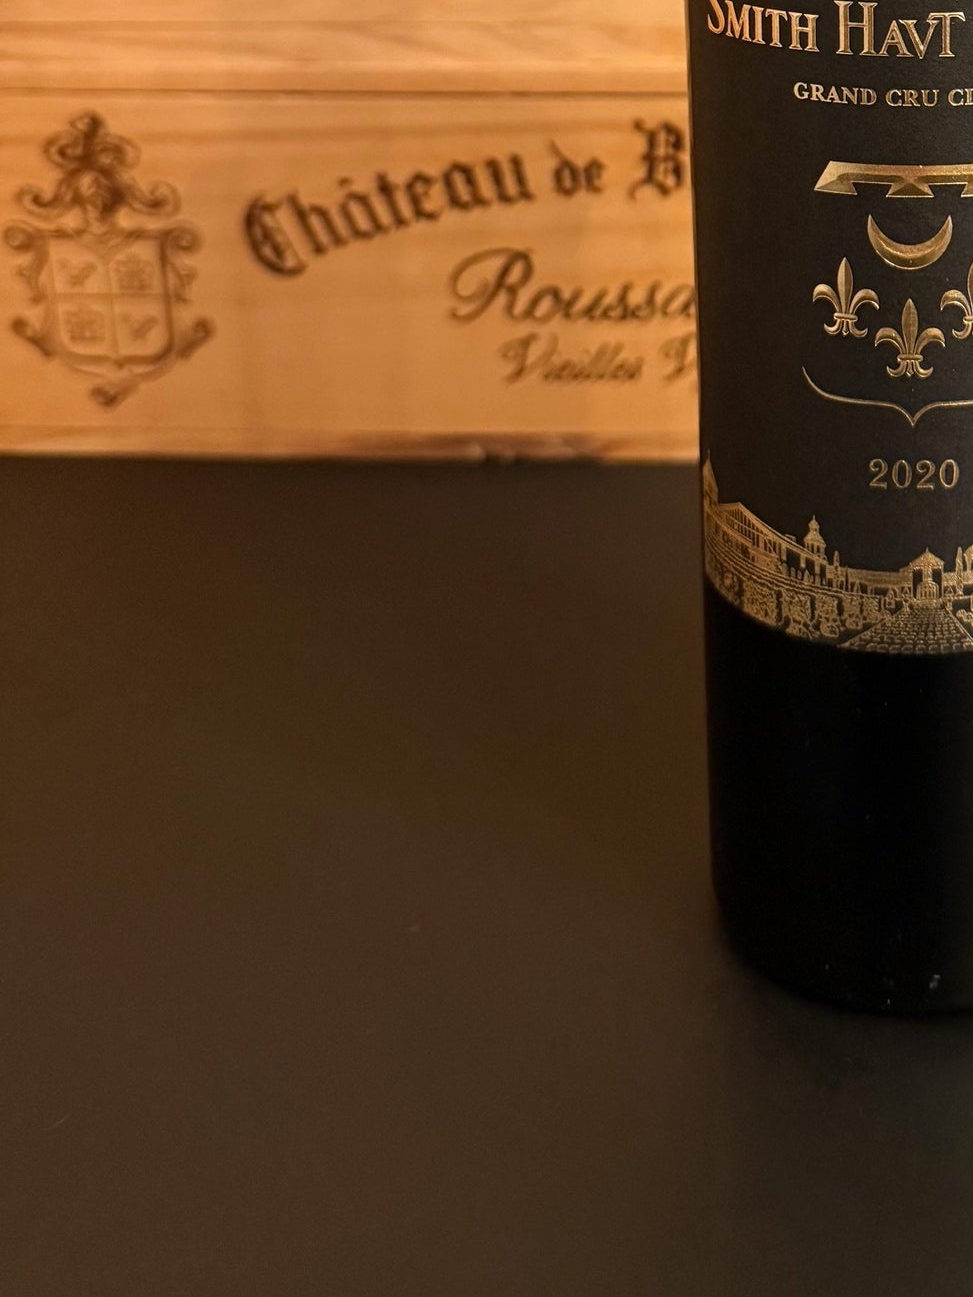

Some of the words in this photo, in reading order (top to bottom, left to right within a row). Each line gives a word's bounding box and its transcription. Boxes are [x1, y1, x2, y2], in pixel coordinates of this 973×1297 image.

[793, 80, 878, 106] GRAND
[885, 88, 939, 108] CRU
[242, 152, 537, 278] Château
[549, 140, 606, 197] de
[868, 458, 961, 490] 2020
